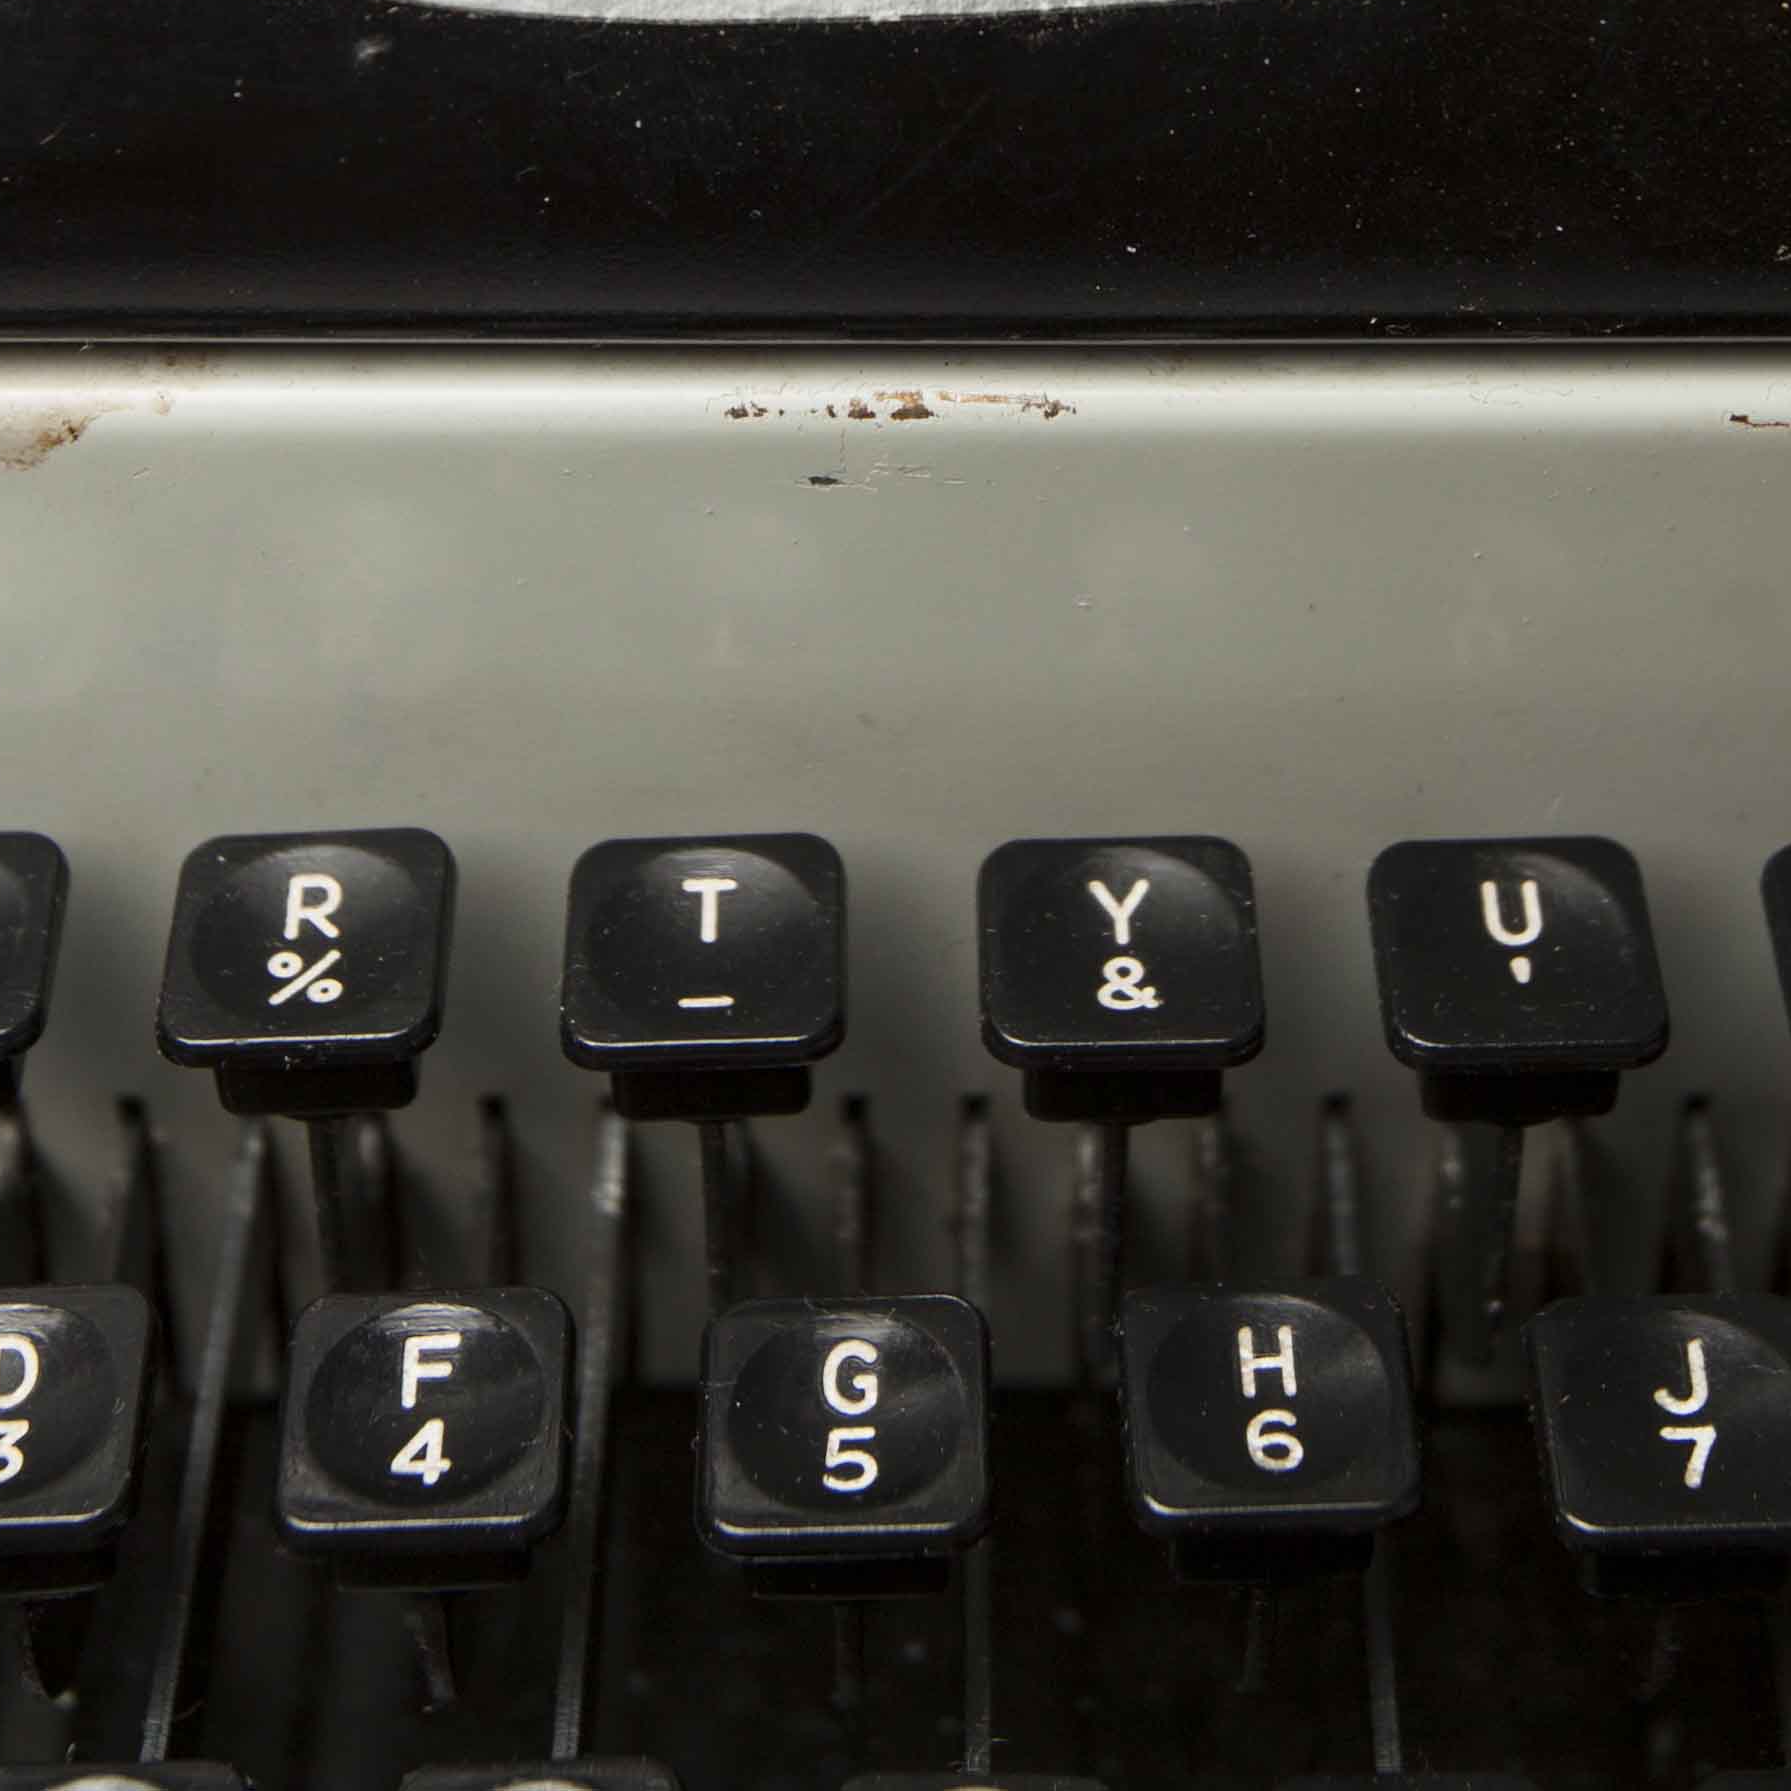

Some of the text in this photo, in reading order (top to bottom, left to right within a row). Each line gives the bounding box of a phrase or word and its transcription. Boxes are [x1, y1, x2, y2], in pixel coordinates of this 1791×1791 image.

[282, 871, 344, 942] R
[680, 876, 740, 944] T
[1088, 877, 1151, 946] Y
[1481, 880, 1544, 947] U
[266, 949, 344, 1006] %
[1096, 955, 1161, 1011] &
[400, 1329, 463, 1410] F
[821, 1338, 880, 1417] G
[1237, 1324, 1298, 1399] H
[1654, 1338, 1710, 1416] J
[389, 1418, 452, 1486] 4
[821, 1426, 879, 1492] 5
[1245, 1409, 1305, 1471] 6
[1659, 1425, 1718, 1489] 7
